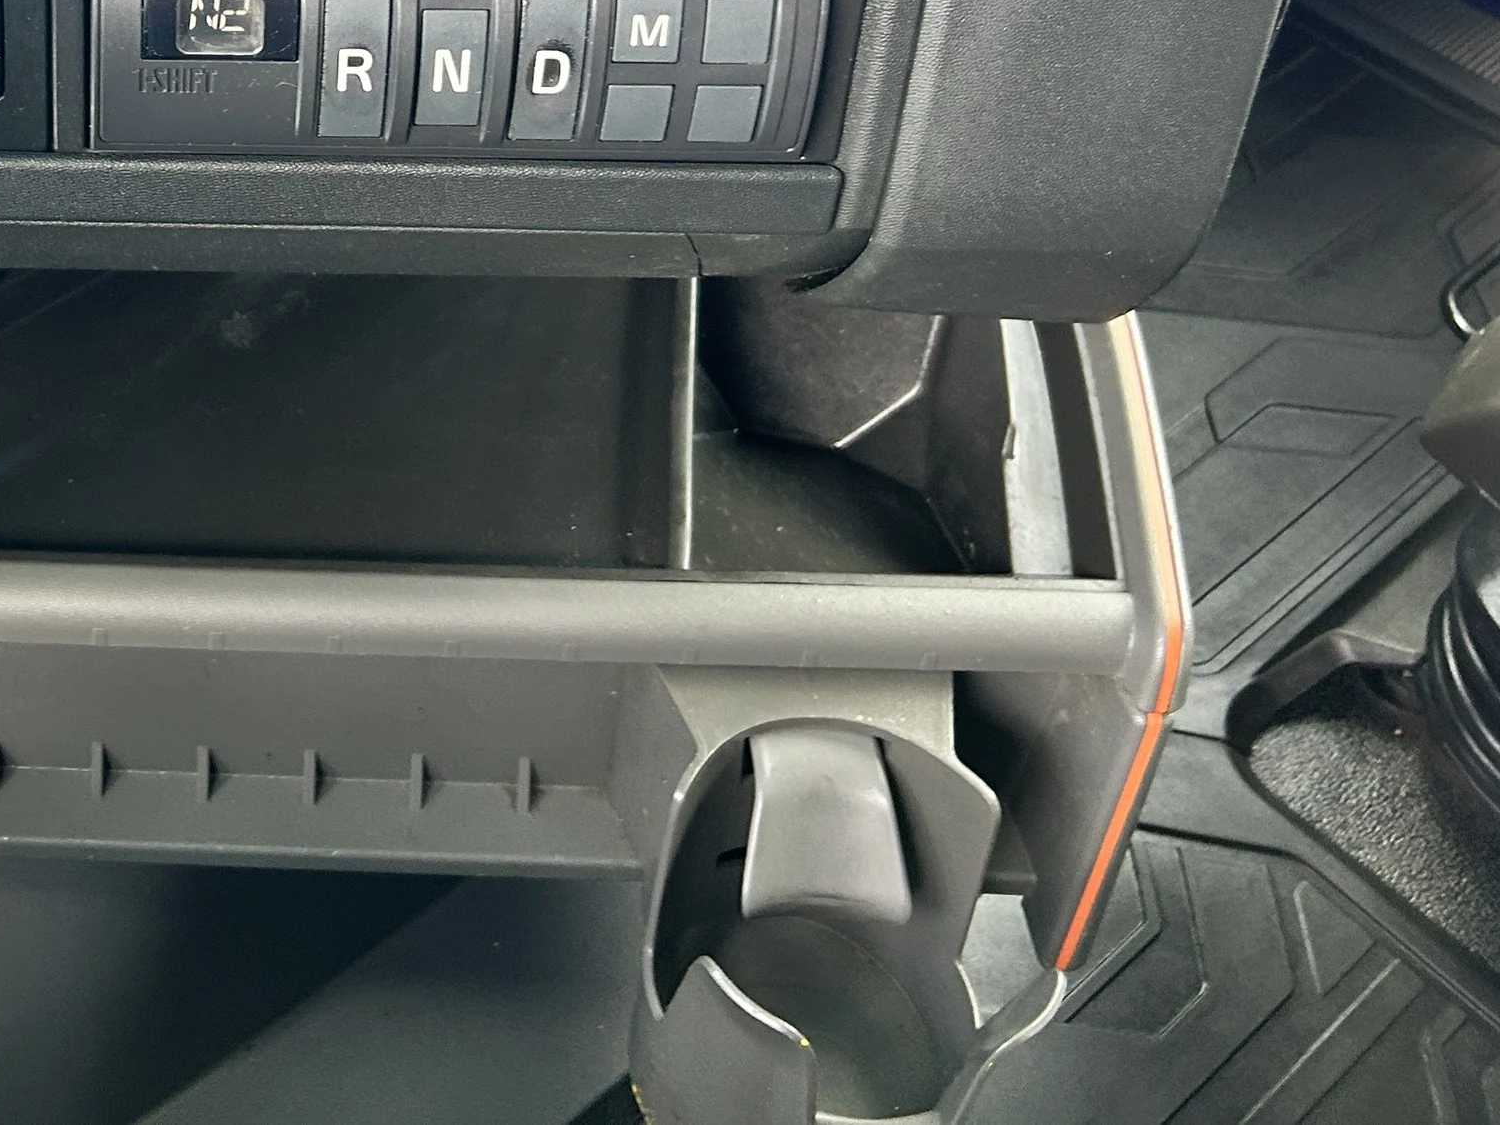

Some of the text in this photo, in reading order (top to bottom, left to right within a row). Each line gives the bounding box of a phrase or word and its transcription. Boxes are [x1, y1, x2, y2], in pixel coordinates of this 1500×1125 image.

[629, 13, 670, 48] M
[336, 48, 374, 93] R
[431, 48, 472, 94] N
[531, 49, 572, 95] D
